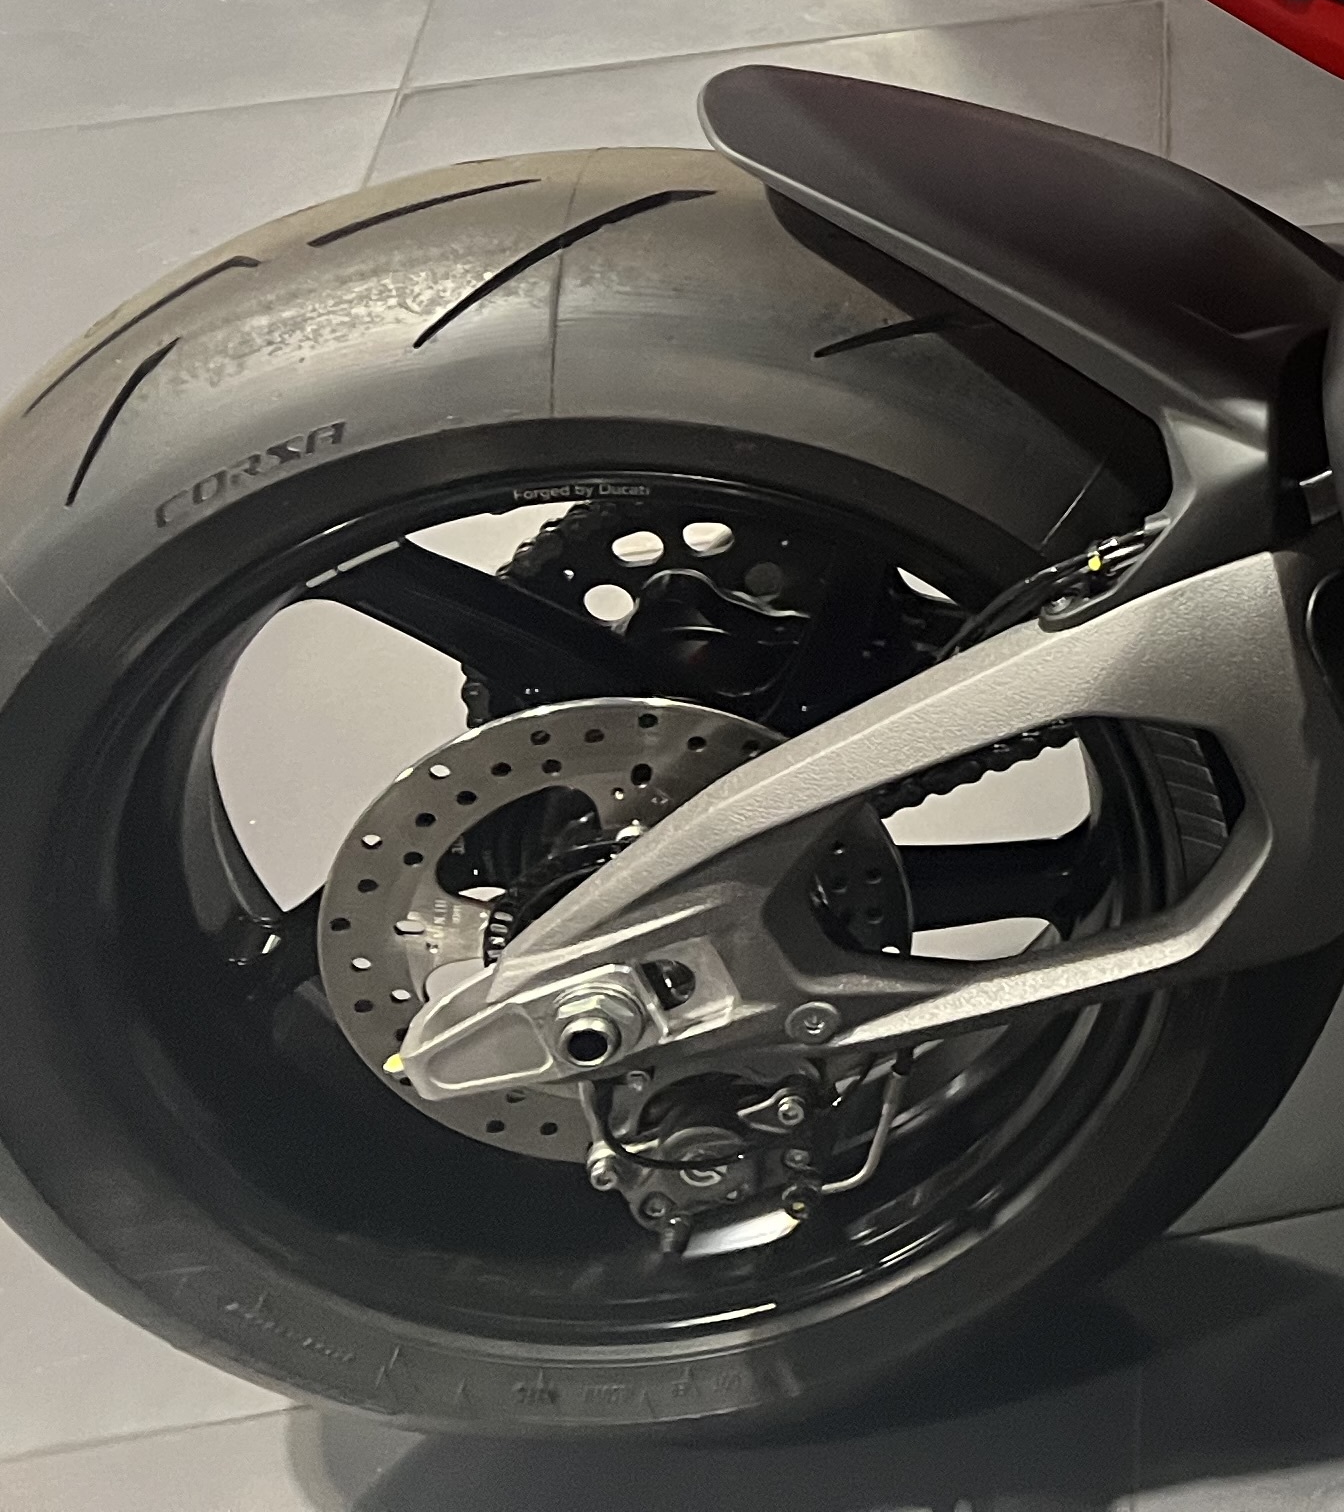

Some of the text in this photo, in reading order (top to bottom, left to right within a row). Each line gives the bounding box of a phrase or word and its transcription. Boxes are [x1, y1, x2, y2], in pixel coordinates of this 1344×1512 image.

[155, 419, 347, 529] CORSA
[513, 484, 650, 501] Forged by Ducati
